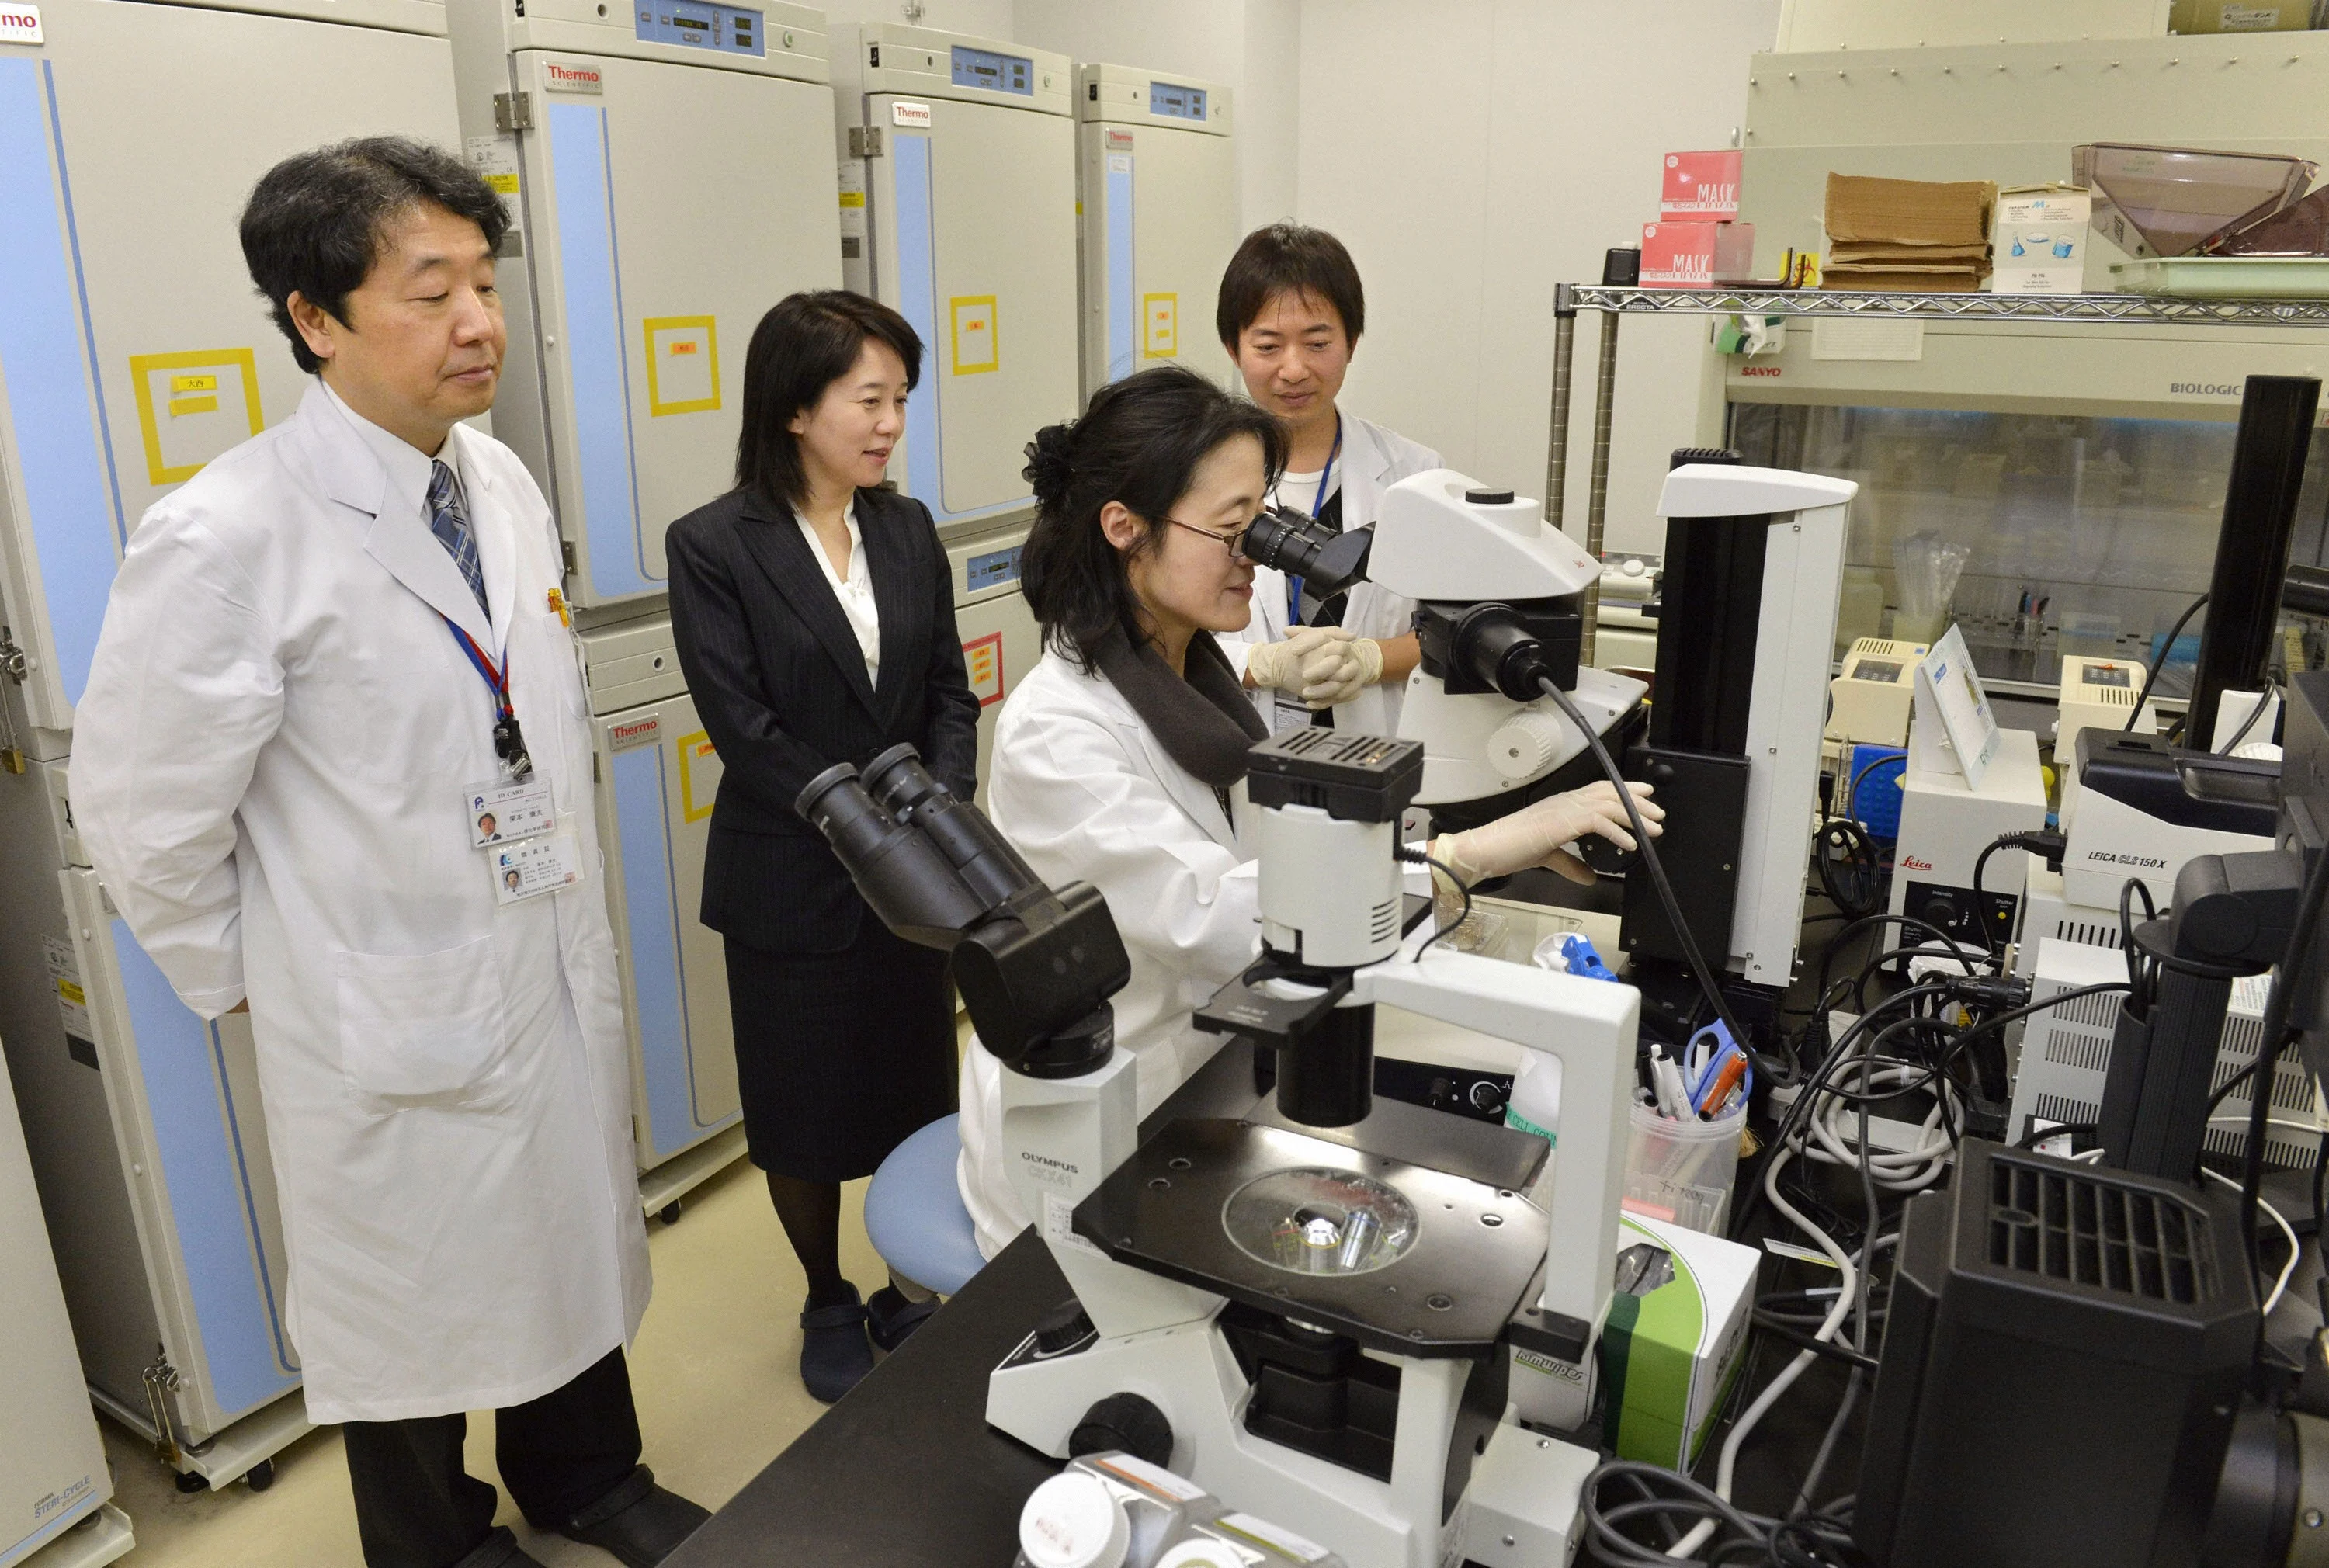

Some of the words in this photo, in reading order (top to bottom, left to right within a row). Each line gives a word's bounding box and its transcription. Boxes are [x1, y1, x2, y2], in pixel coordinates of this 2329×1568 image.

[548, 65, 599, 82] Thermo
[897, 106, 928, 119] Thermo
[1109, 130, 1133, 142] Thermo
[1698, 183, 1735, 203] MASK
[1673, 254, 1710, 272] MASK
[1742, 366, 1781, 376] SANYO
[2171, 383, 2243, 396] BIOLOGIC
[613, 720, 657, 739] Thermo
[507, 789, 524, 797] CARD
[1900, 855, 1932, 871] Leica
[2088, 852, 2116, 862] LEICA
[2118, 855, 2139, 865] CLS
[2140, 858, 2157, 867] 150
[2157, 860, 2167, 869] X
[1022, 1152, 1078, 1174] OLYMPUS
[35, 1475, 90, 1519] STERI-CYCLE
